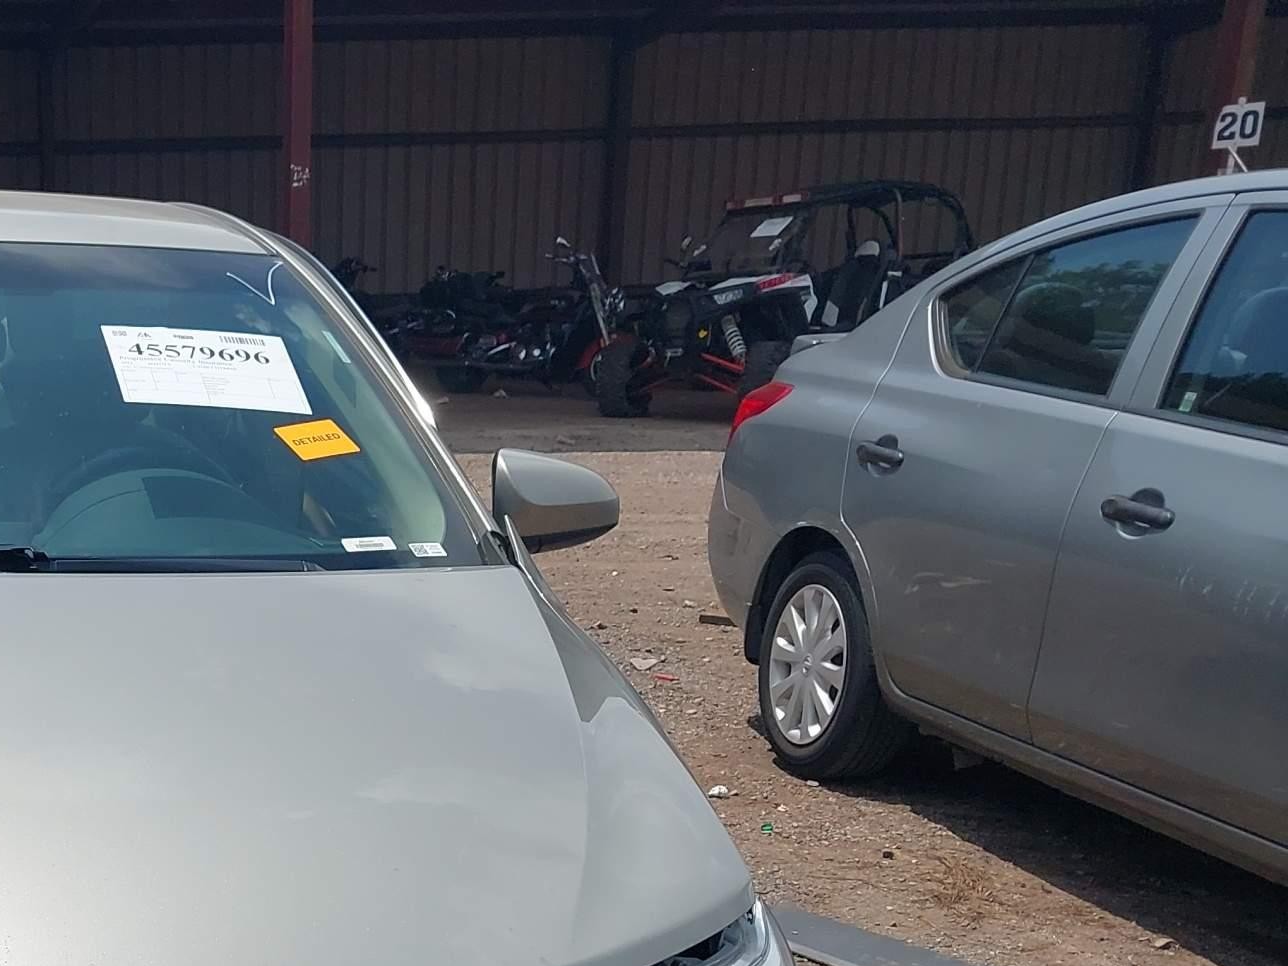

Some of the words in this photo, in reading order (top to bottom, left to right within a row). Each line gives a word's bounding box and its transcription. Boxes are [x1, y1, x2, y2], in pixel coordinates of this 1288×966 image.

[1217, 110, 1259, 141] 20
[128, 343, 270, 365] 45579696
[292, 432, 341, 447] DETAILED
